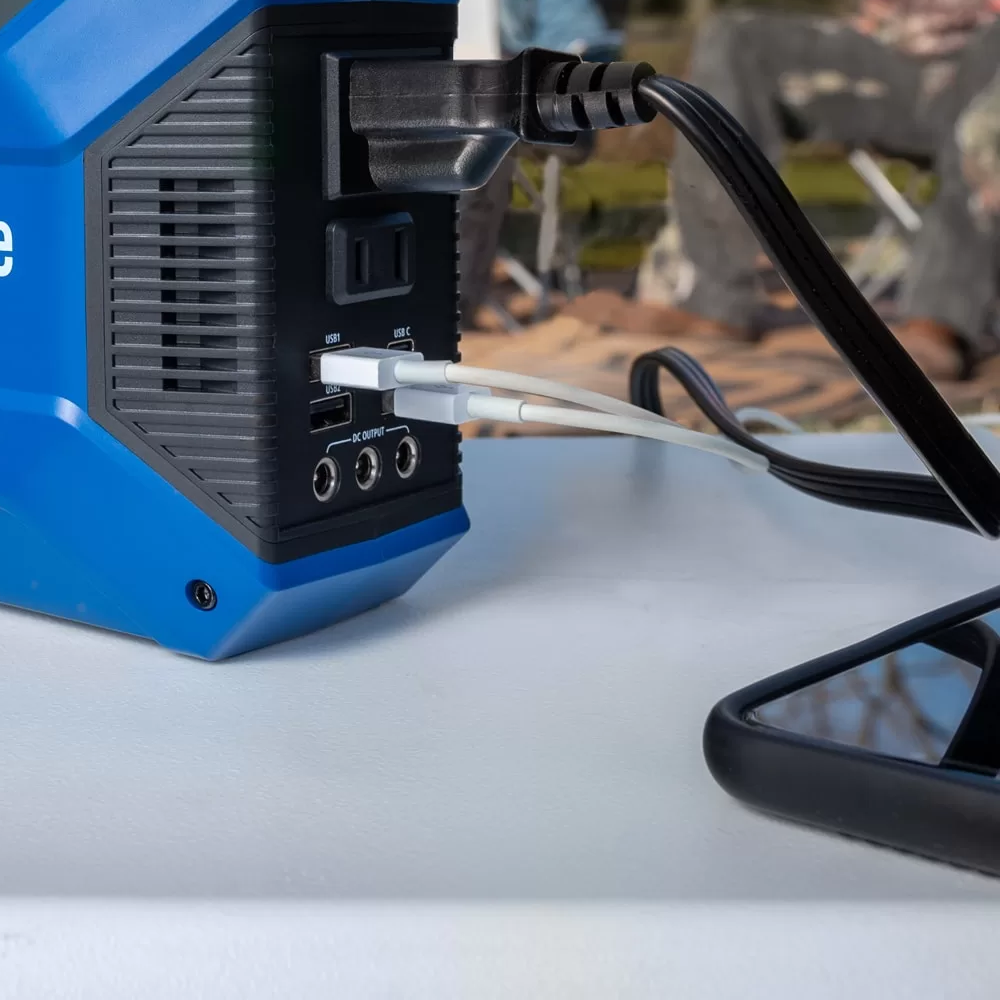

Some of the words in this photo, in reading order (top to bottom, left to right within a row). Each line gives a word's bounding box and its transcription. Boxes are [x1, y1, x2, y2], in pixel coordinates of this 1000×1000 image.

[393, 328, 405, 338] USB
[406, 326, 411, 336] C
[325, 333, 341, 345] USB1
[352, 432, 361, 443] DC
[362, 426, 385, 441] OUTPUT
